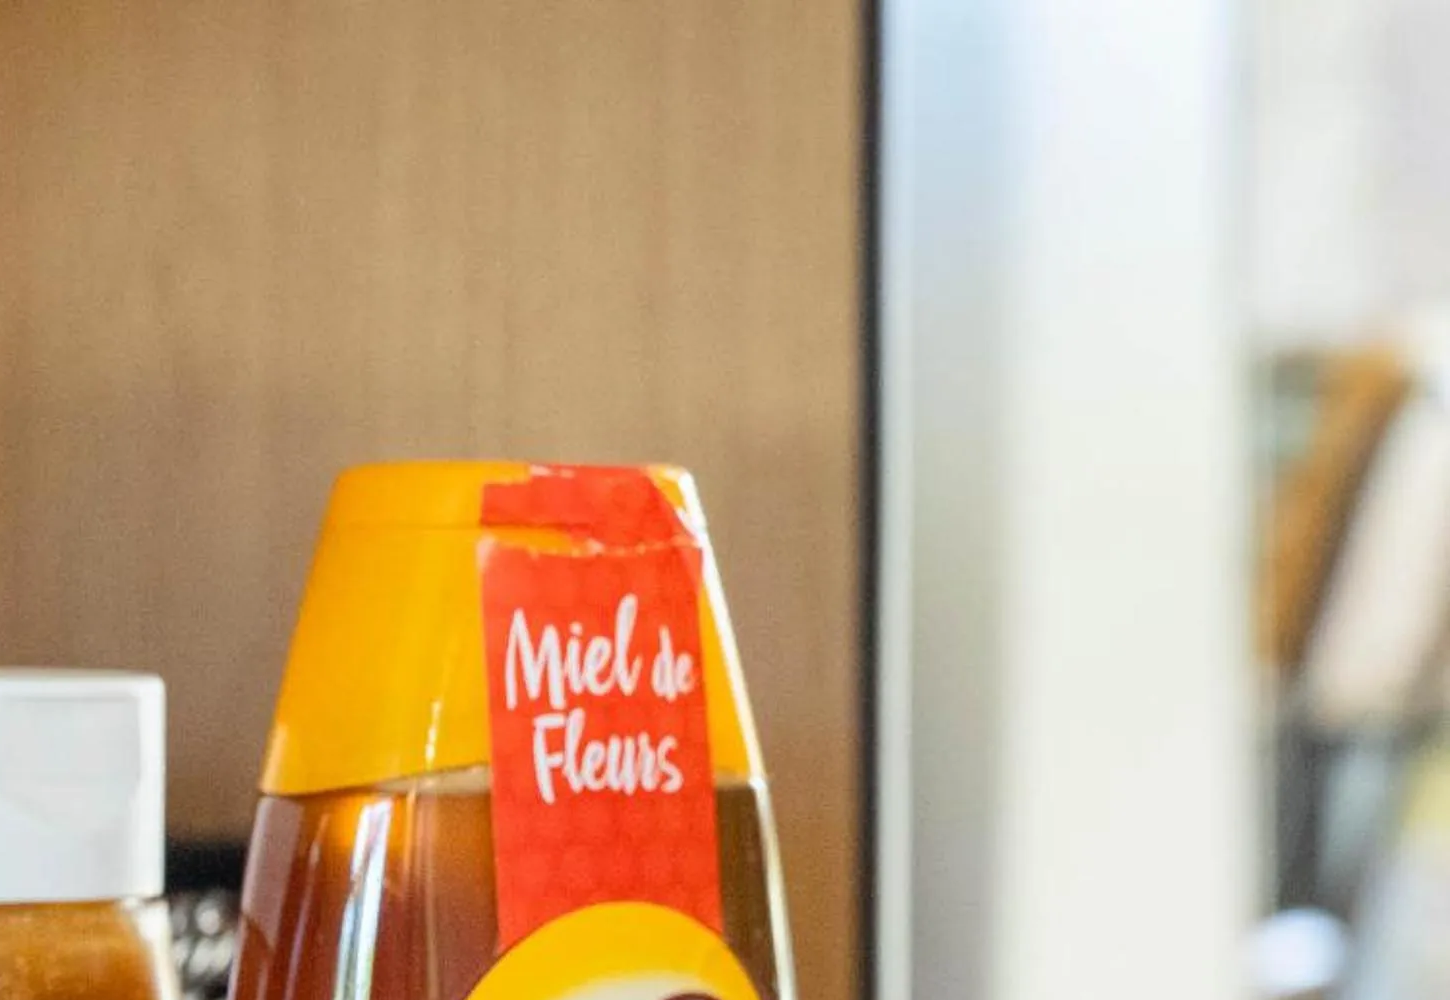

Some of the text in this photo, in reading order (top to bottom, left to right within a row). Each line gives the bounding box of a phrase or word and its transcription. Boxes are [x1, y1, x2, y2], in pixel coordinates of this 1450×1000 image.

[505, 593, 695, 711] Miel de
[533, 707, 684, 805] Fleurs
